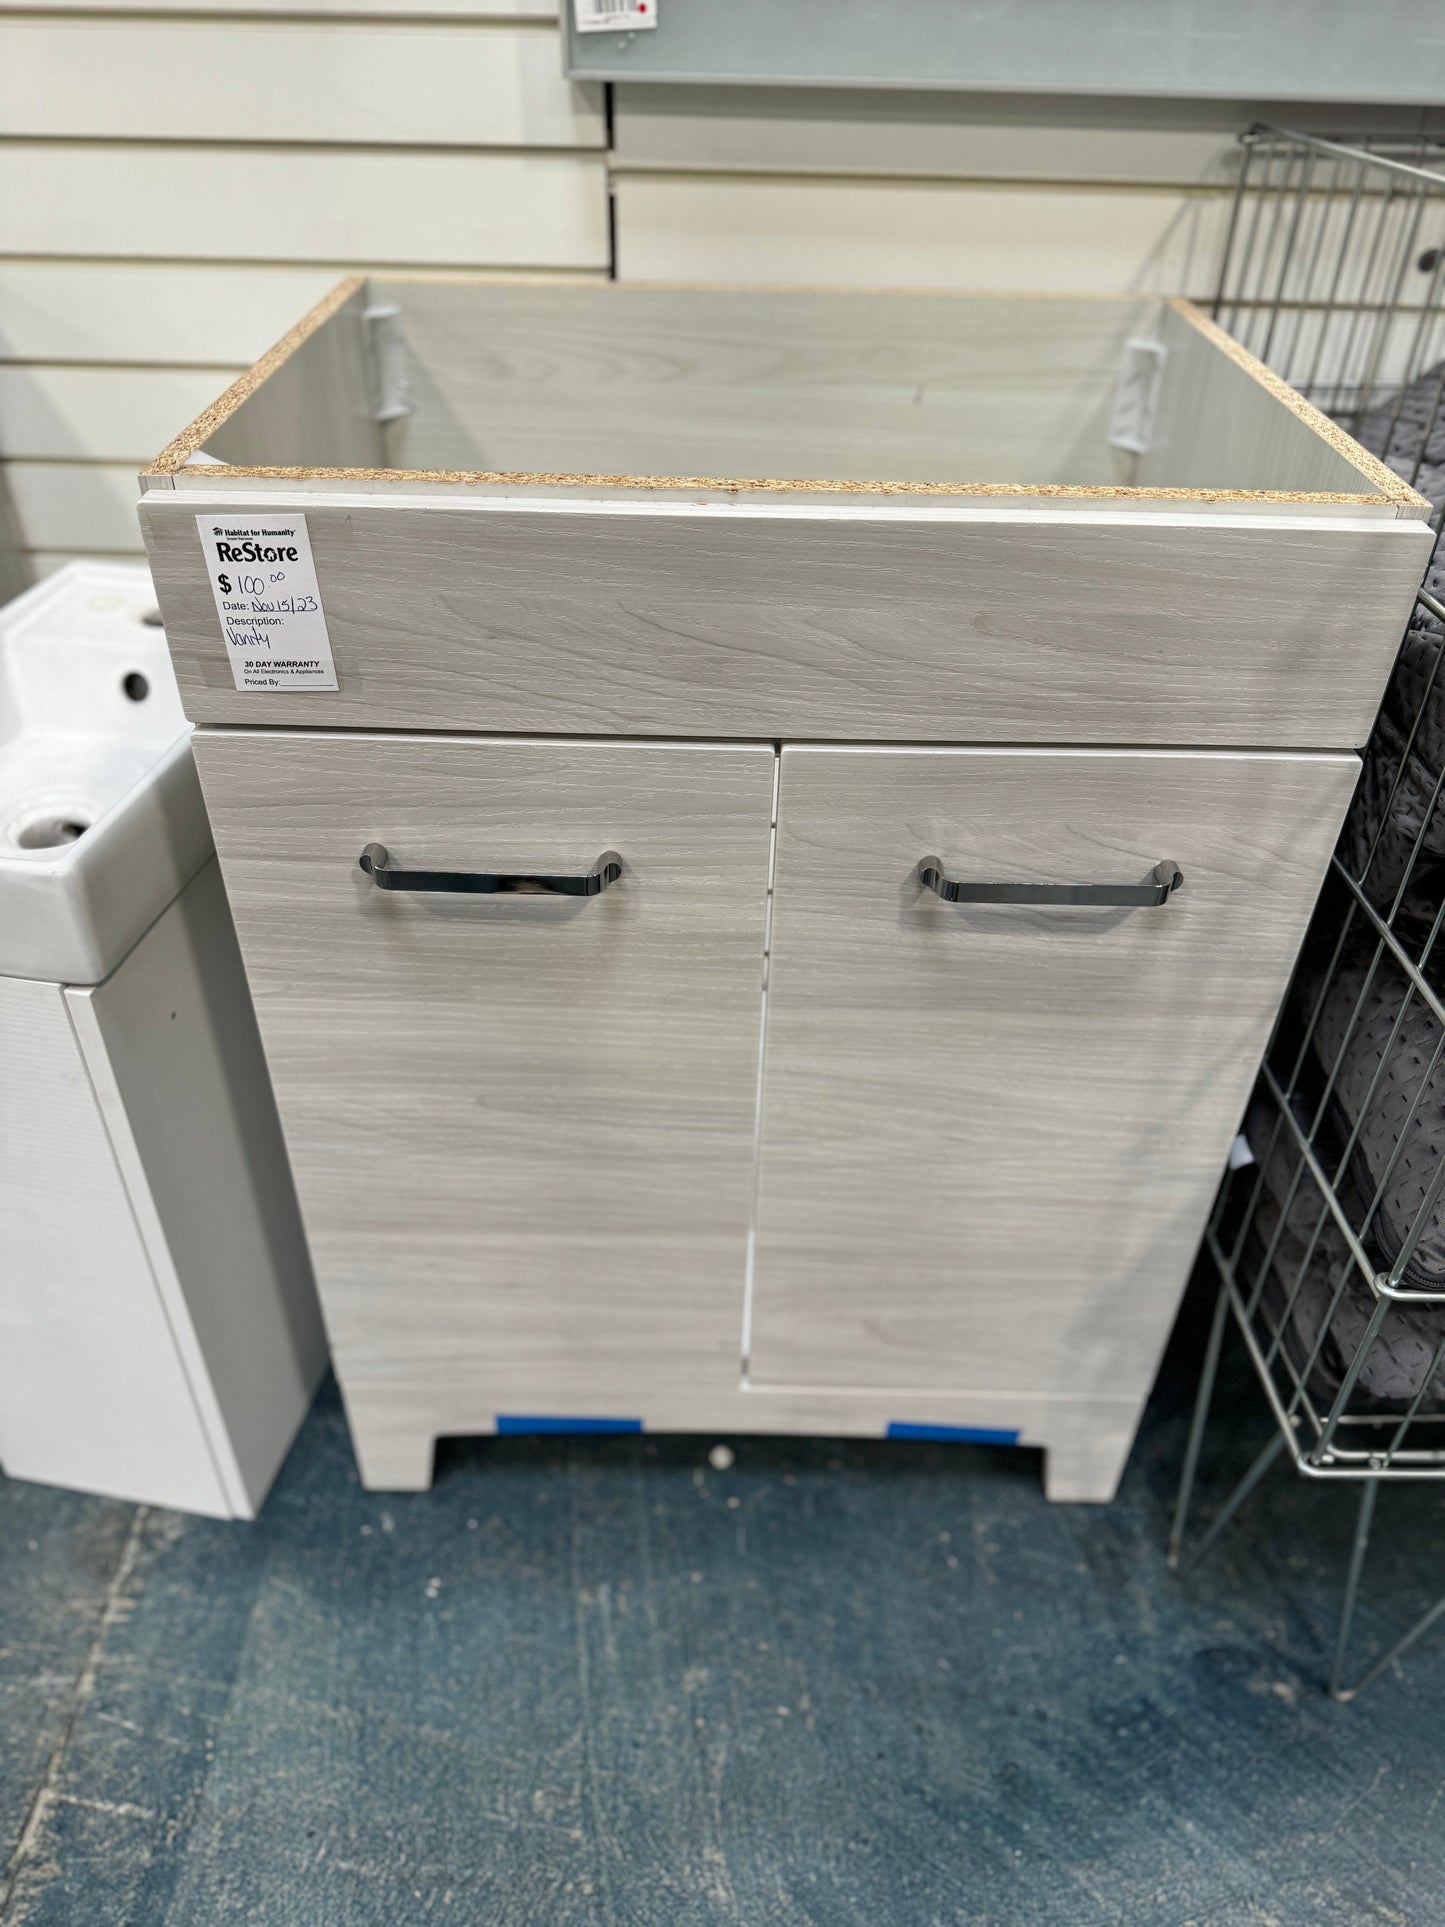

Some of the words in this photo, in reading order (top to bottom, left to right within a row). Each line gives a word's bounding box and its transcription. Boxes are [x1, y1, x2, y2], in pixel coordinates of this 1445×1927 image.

[216, 542, 298, 562] ReStore
[223, 602, 249, 610] Date:
[227, 617, 284, 626] Description:
[226, 626, 270, 649] Vanity
